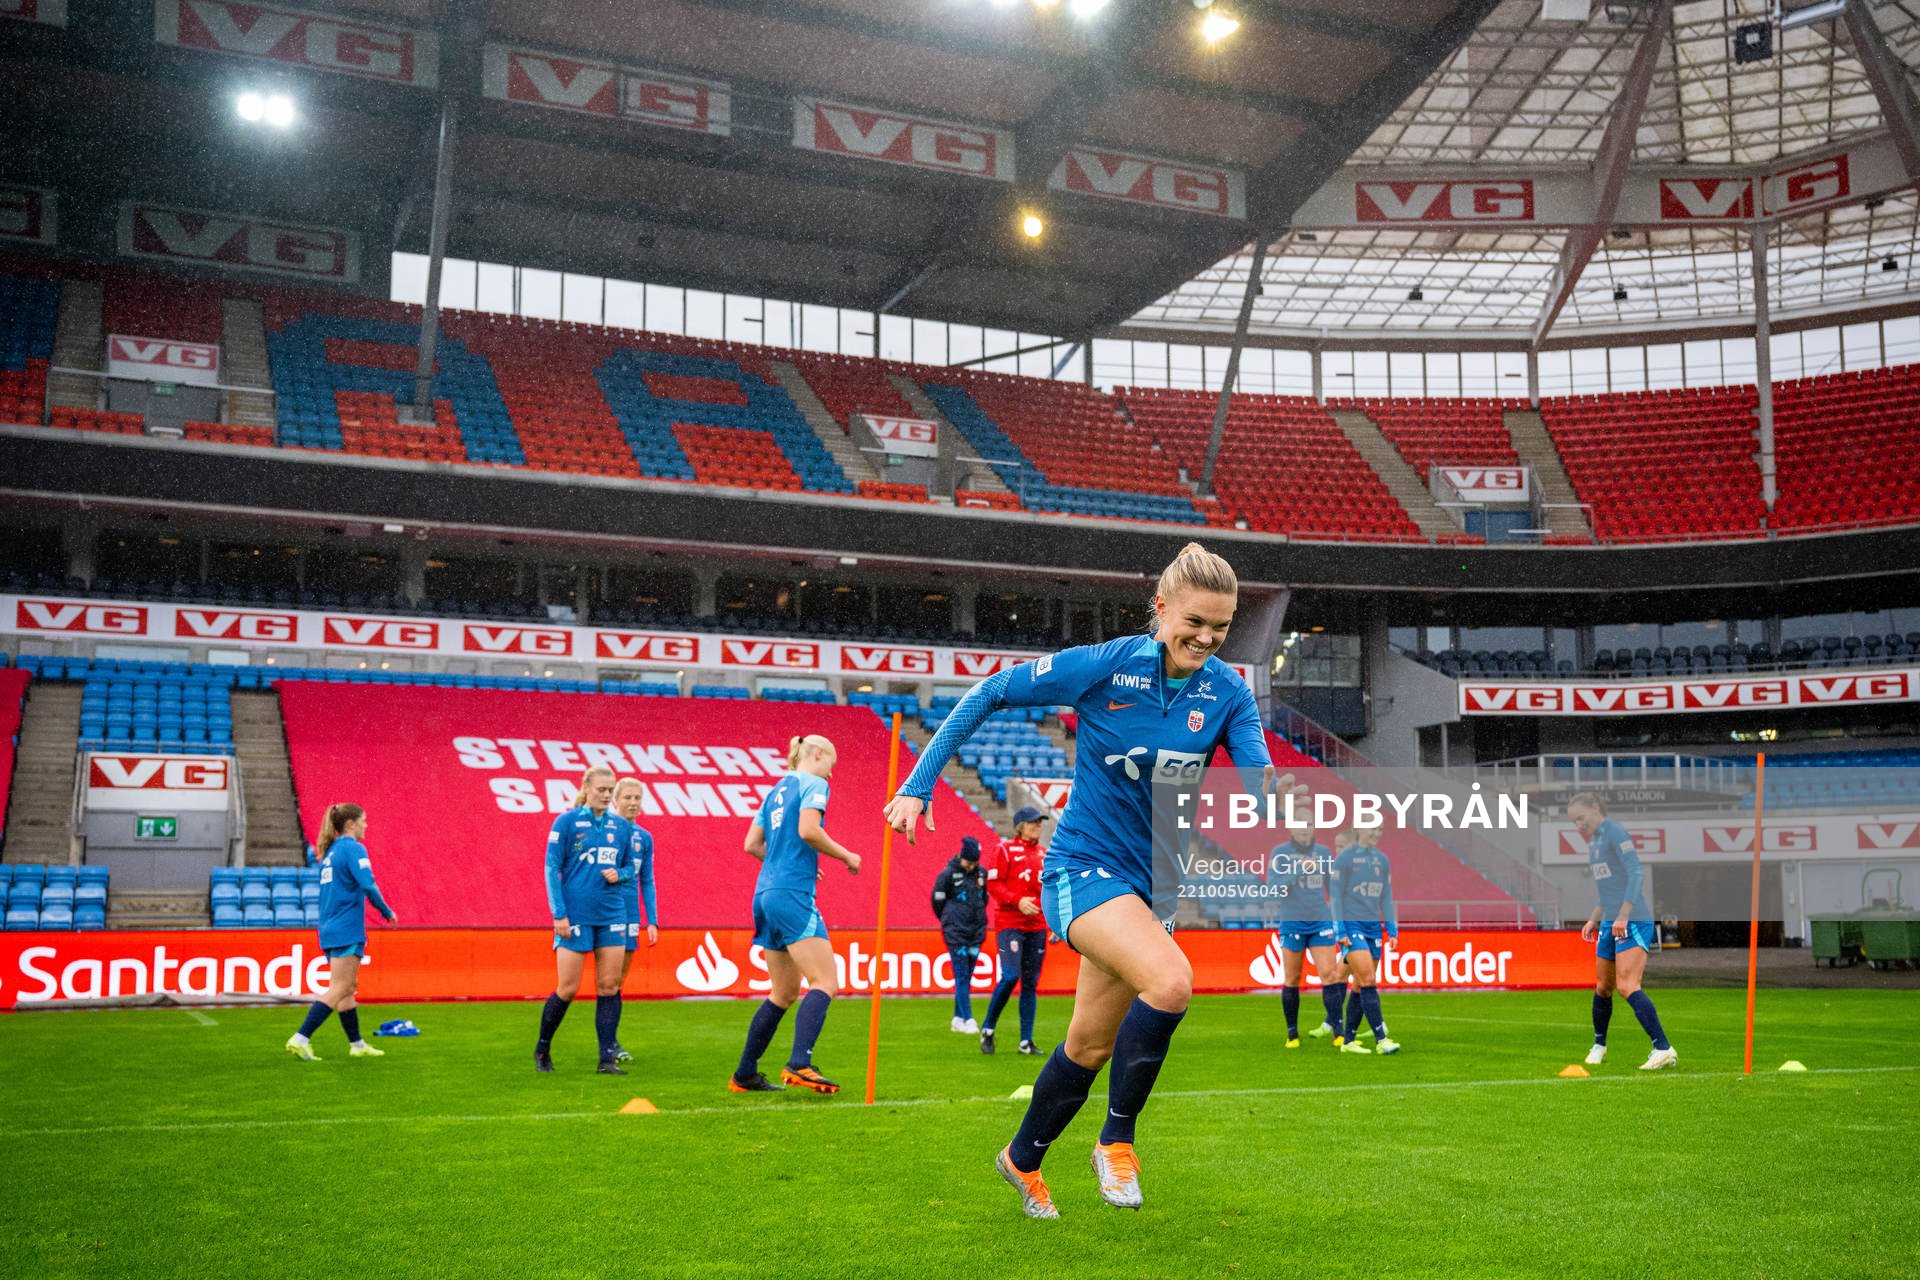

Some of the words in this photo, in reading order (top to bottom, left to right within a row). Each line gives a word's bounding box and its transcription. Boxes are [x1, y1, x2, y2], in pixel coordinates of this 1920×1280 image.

[188, 1, 403, 77] VG
[512, 52, 703, 125] VG
[819, 106, 990, 171] VG
[1068, 151, 1222, 211] VG
[1663, 159, 1842, 218] VG
[1361, 183, 1525, 219] VG
[137, 208, 339, 273] VG
[116, 340, 211, 368] VG
[863, 418, 932, 441] VG
[1447, 471, 1518, 488] VG
[20, 603, 144, 633] VG
[180, 611, 293, 640] VG
[329, 619, 434, 646] VG
[468, 626, 568, 654] VG
[599, 634, 694, 661] VG
[724, 641, 815, 667] VG
[844, 647, 930, 672] VG
[1112, 673, 1140, 688] KIWI
[1467, 689, 1560, 710] VG
[1575, 687, 1669, 710] VG
[1686, 682, 1784, 707] VG
[1801, 674, 1902, 700] VG
[93, 757, 226, 789] VG
[452, 736, 789, 777] STERKERE
[1159, 758, 1200, 780] 5G
[1616, 790, 1666, 801] STADION
[1705, 826, 1812, 851] VG
